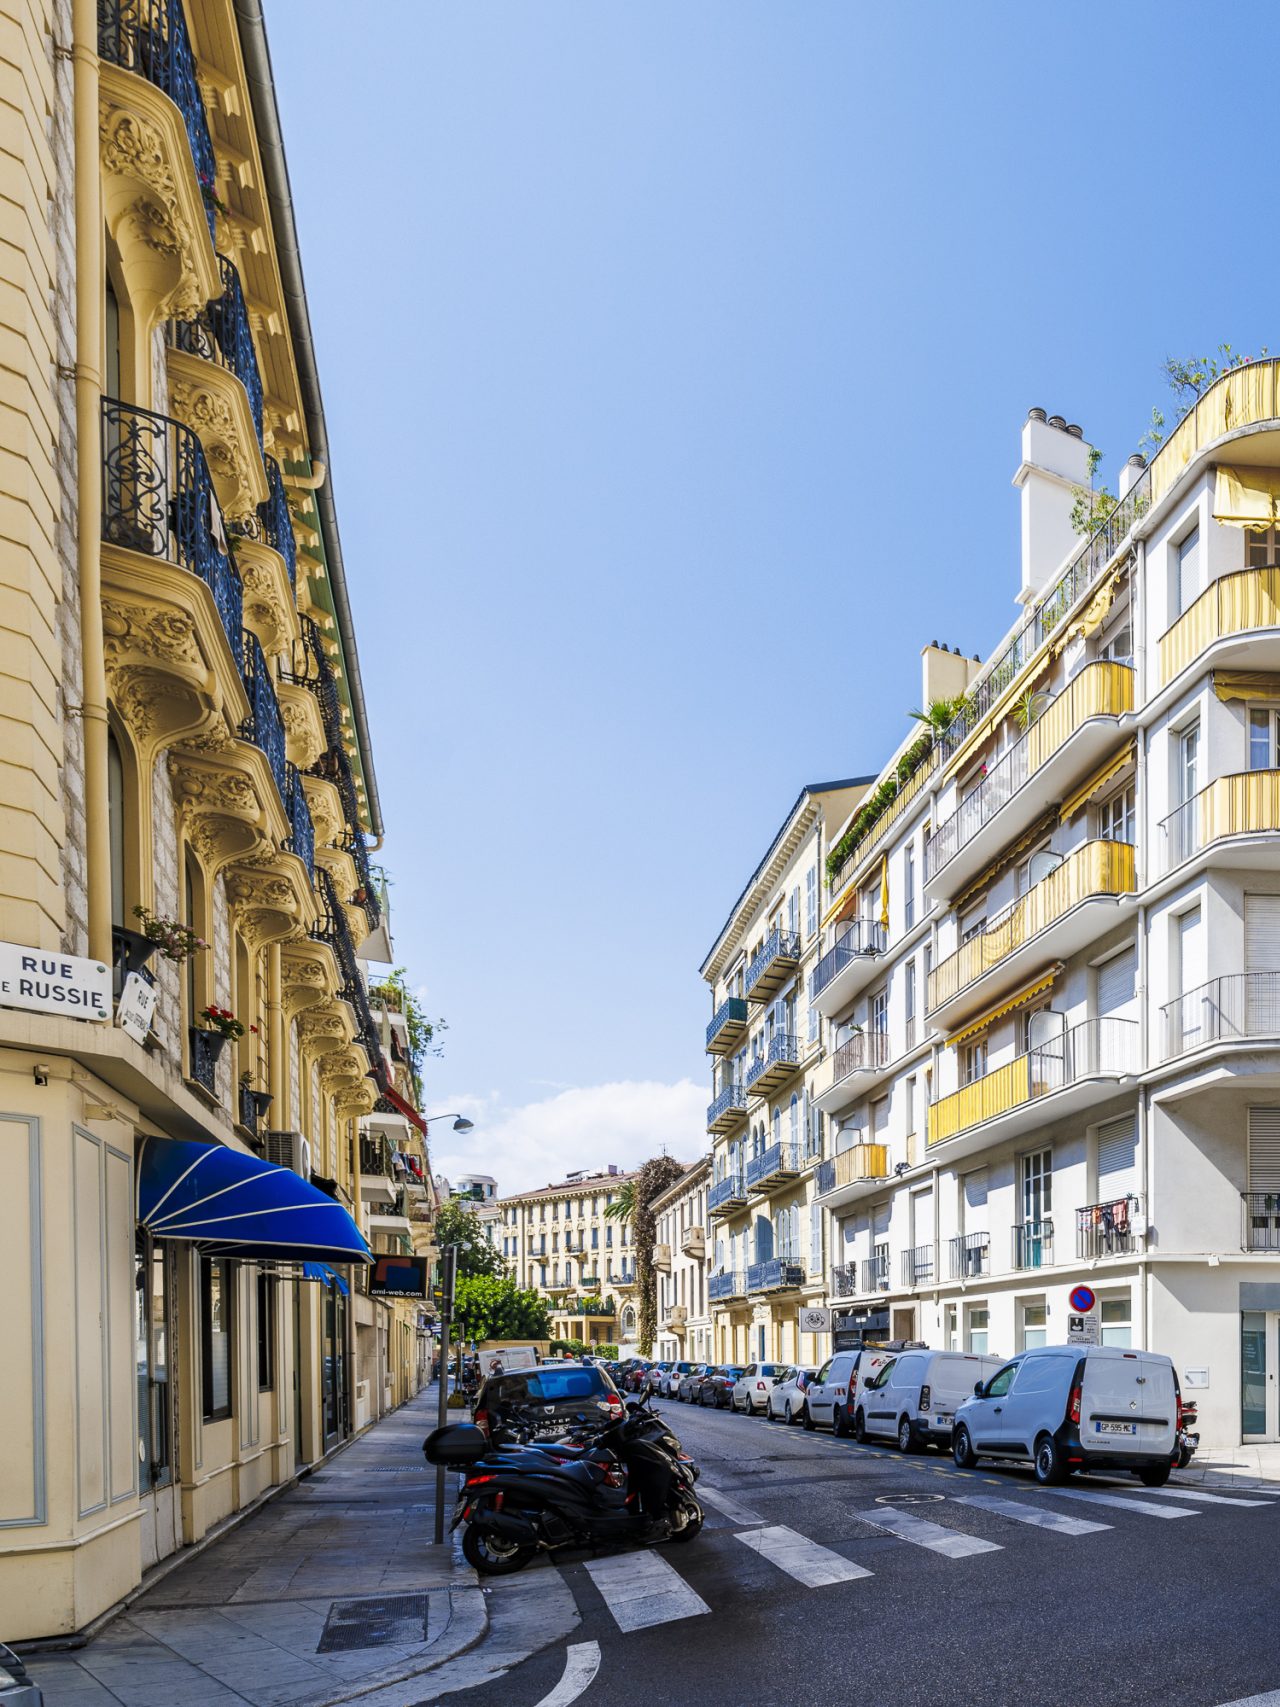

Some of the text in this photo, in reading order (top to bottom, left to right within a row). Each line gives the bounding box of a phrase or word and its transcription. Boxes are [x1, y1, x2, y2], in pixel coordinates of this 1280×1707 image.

[21, 955, 73, 979] RUE
[2, 977, 104, 1009] E RUSSIE
[137, 989, 149, 1009] RUE
[540, 1417, 571, 1425] STER
